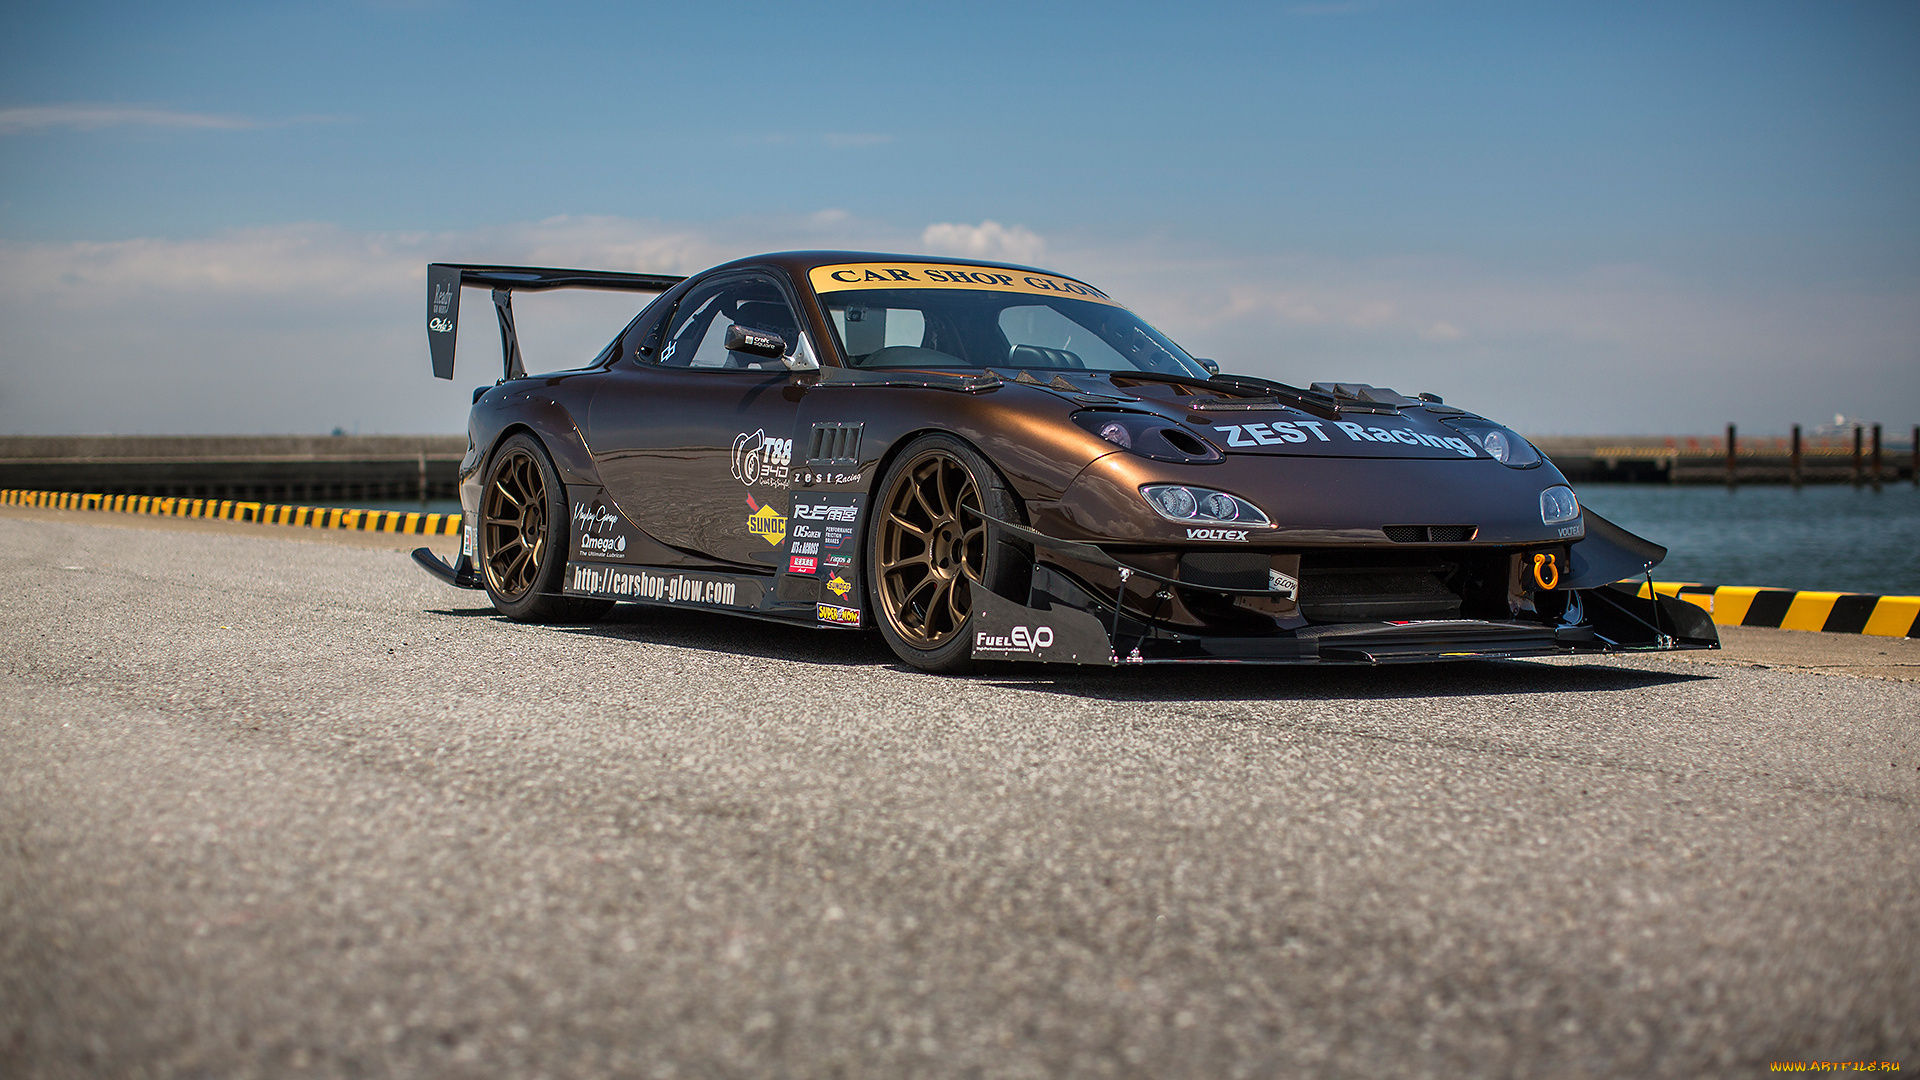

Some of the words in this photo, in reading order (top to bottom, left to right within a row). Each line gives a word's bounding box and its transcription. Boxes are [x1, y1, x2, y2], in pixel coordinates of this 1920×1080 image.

[830, 268, 921, 283] CAR
[923, 268, 1015, 287] SHOP
[1213, 420, 1336, 448] ZEST
[1333, 421, 1478, 458] Racing
[762, 437, 793, 466] T88
[834, 473, 862, 485] Racing
[793, 525, 810, 538] OS
[1186, 528, 1249, 541] VOLTEX
[1557, 525, 1581, 537] VOLTEX
[573, 565, 737, 606] http://carshop-glow.com
[828, 581, 851, 591] SUNOCO
[818, 605, 839, 621] SUPER
[1011, 626, 1054, 653] EVO
